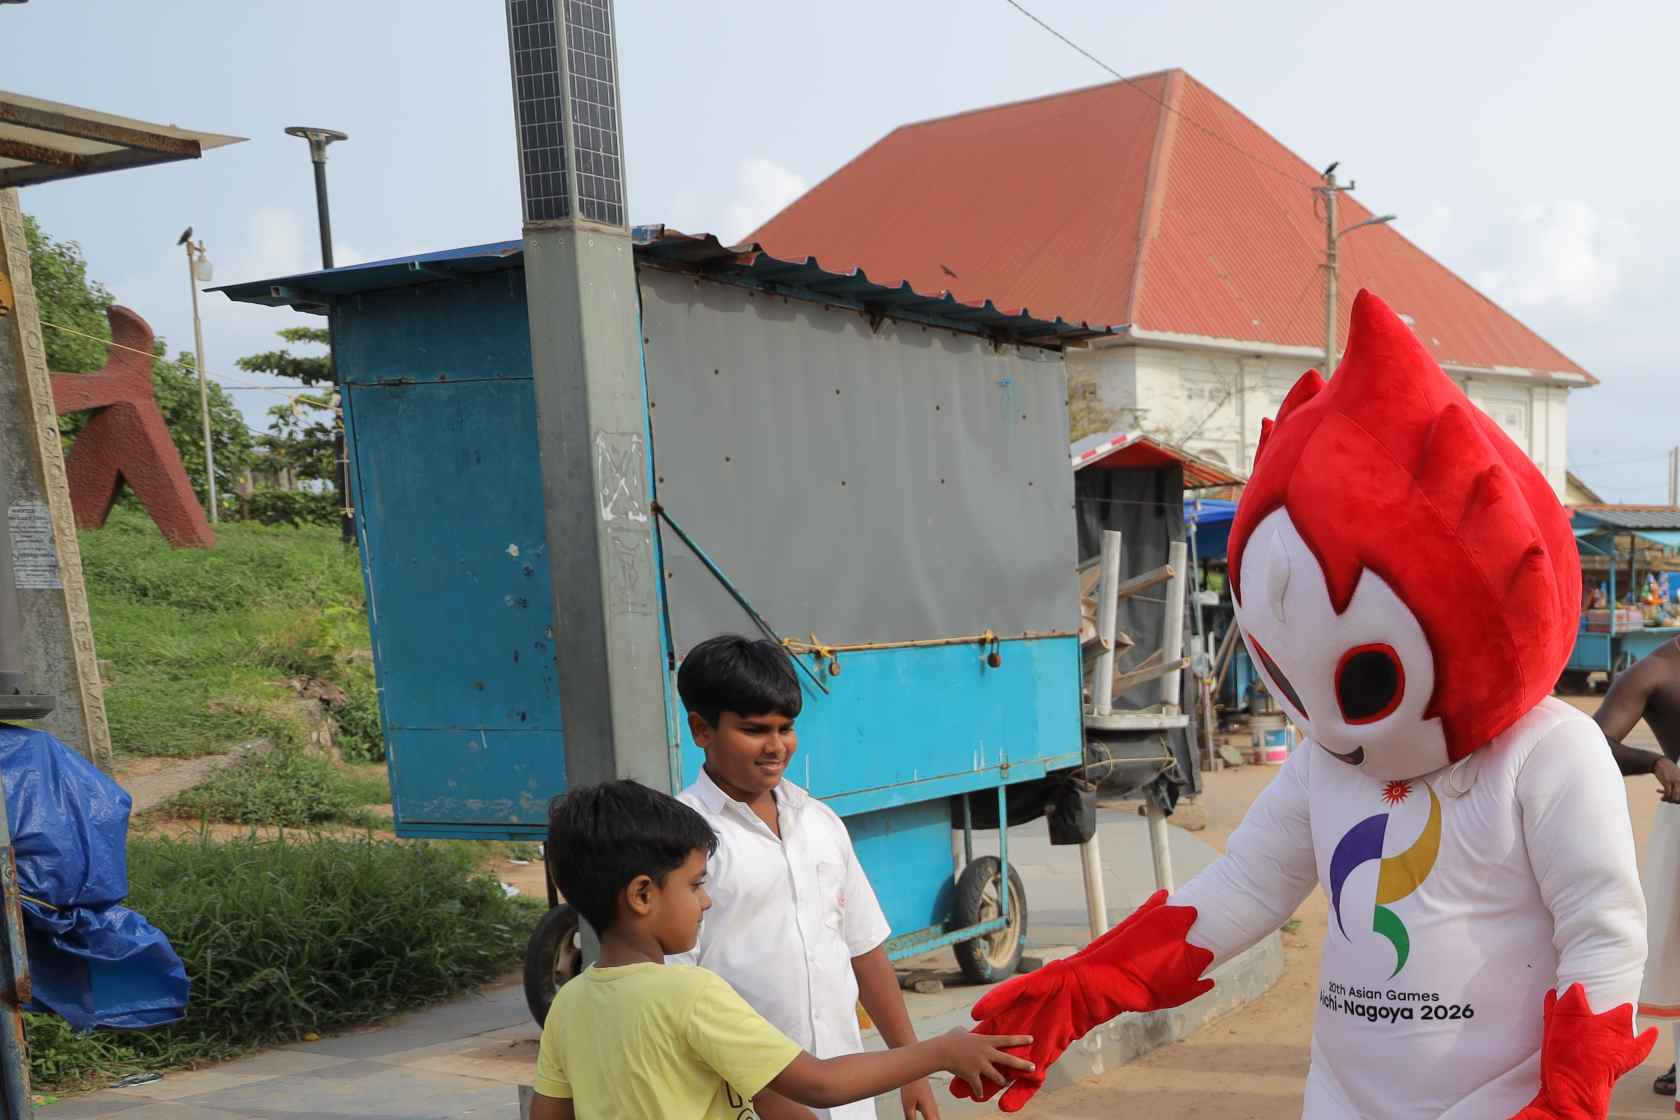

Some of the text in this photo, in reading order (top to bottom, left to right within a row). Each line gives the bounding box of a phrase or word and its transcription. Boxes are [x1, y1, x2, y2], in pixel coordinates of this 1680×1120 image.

[1348, 986, 1382, 1001] Asian
[1386, 990, 1440, 1002] Games
[1420, 1003, 1475, 1021] 2026
